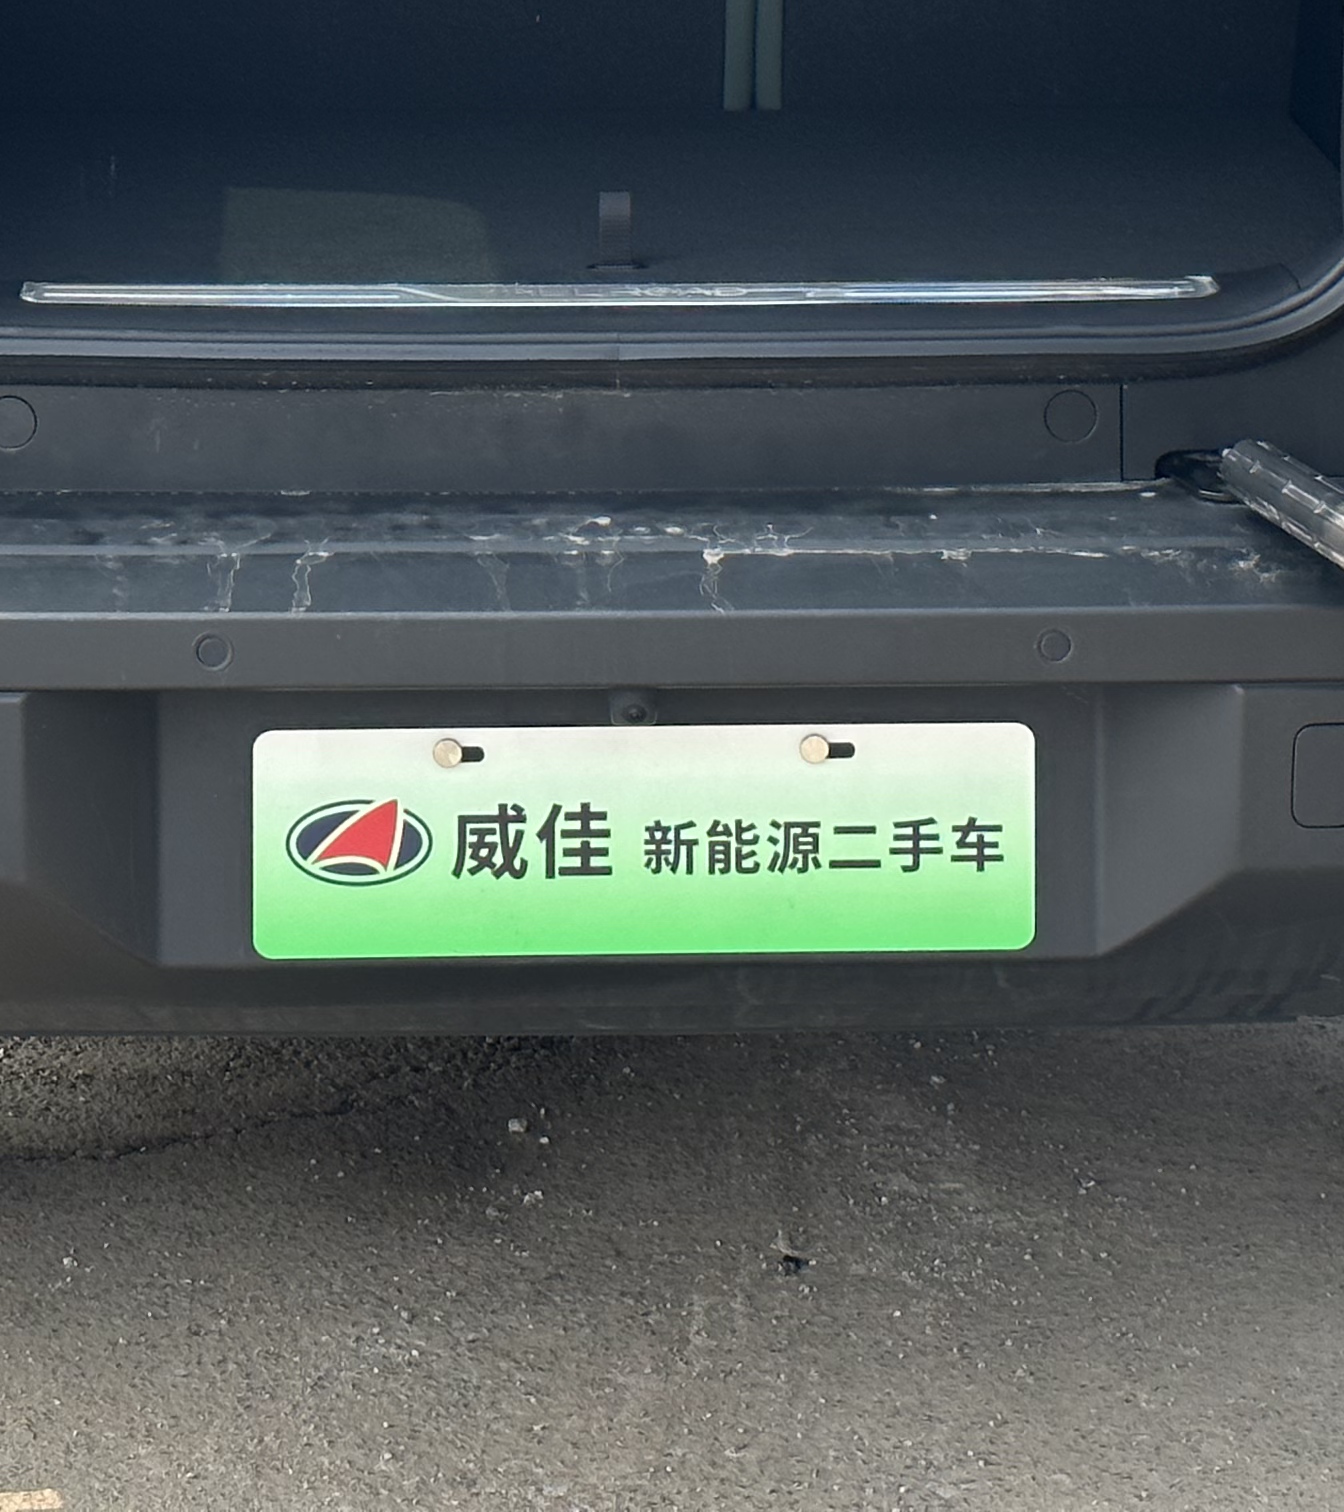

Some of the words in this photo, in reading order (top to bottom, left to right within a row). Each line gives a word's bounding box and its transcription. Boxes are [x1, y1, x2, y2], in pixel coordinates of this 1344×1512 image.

[451, 801, 613, 881] 威佳
[643, 816, 1004, 877] 新能源二手车
